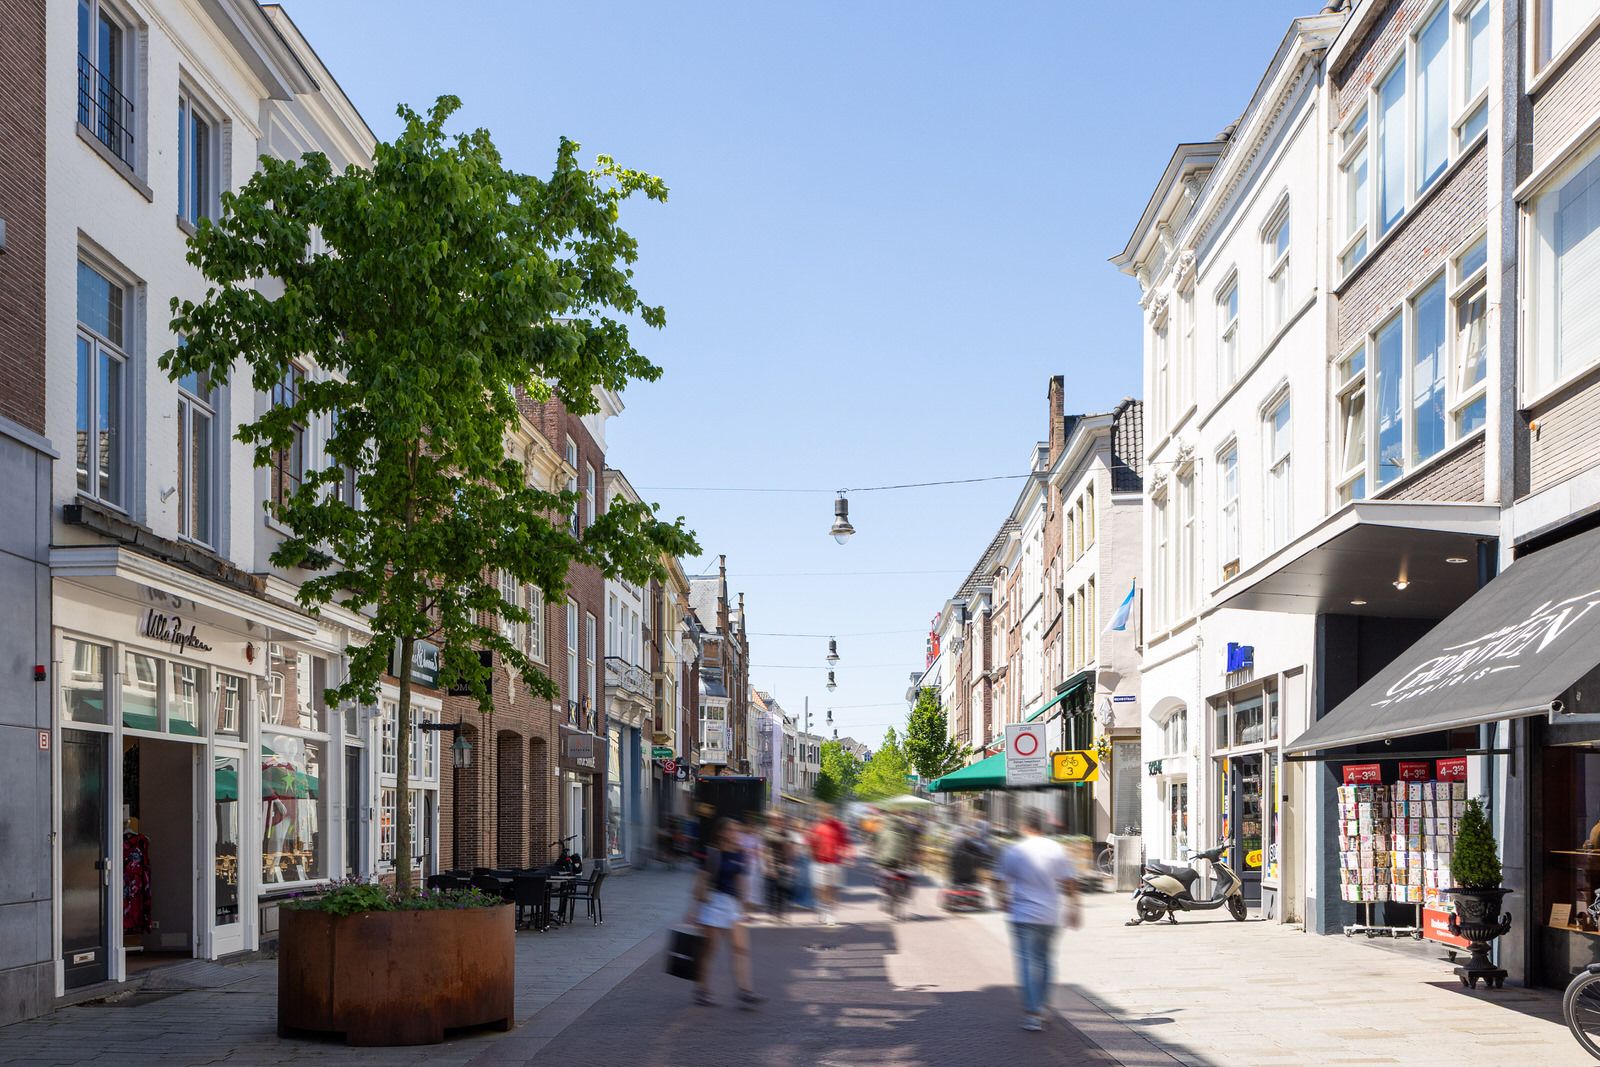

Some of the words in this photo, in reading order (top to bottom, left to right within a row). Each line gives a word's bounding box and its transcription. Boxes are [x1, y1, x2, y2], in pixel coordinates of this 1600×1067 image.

[146, 608, 170, 640] Ulla
[1067, 767, 1074, 776] 3
[1403, 769, 1409, 778] 4
[1440, 766, 1446, 776] 4
[1348, 772, 1355, 780] 4
